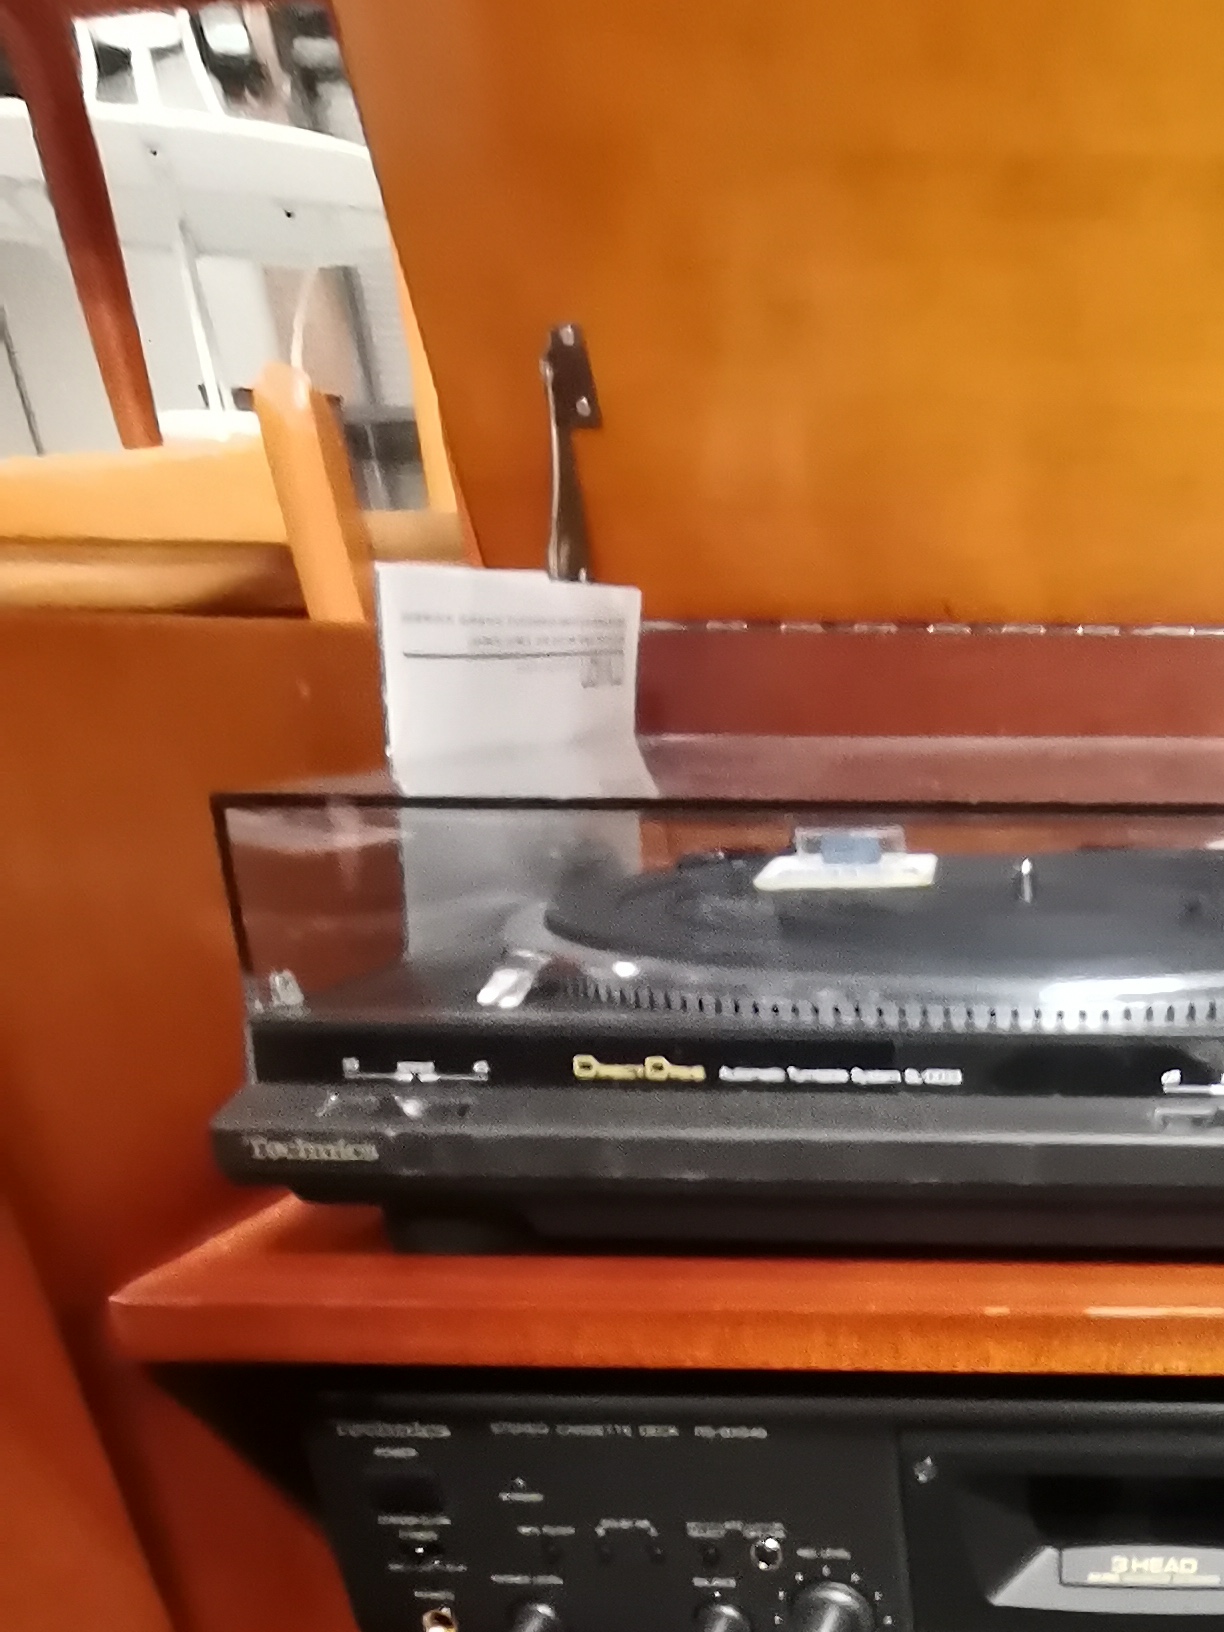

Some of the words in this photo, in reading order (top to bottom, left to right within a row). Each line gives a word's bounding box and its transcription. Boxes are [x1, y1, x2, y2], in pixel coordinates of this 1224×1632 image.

[245, 1133, 379, 1161] Technics
[1111, 1554, 1128, 1574] 3
[1130, 1555, 1199, 1575] HEAD
